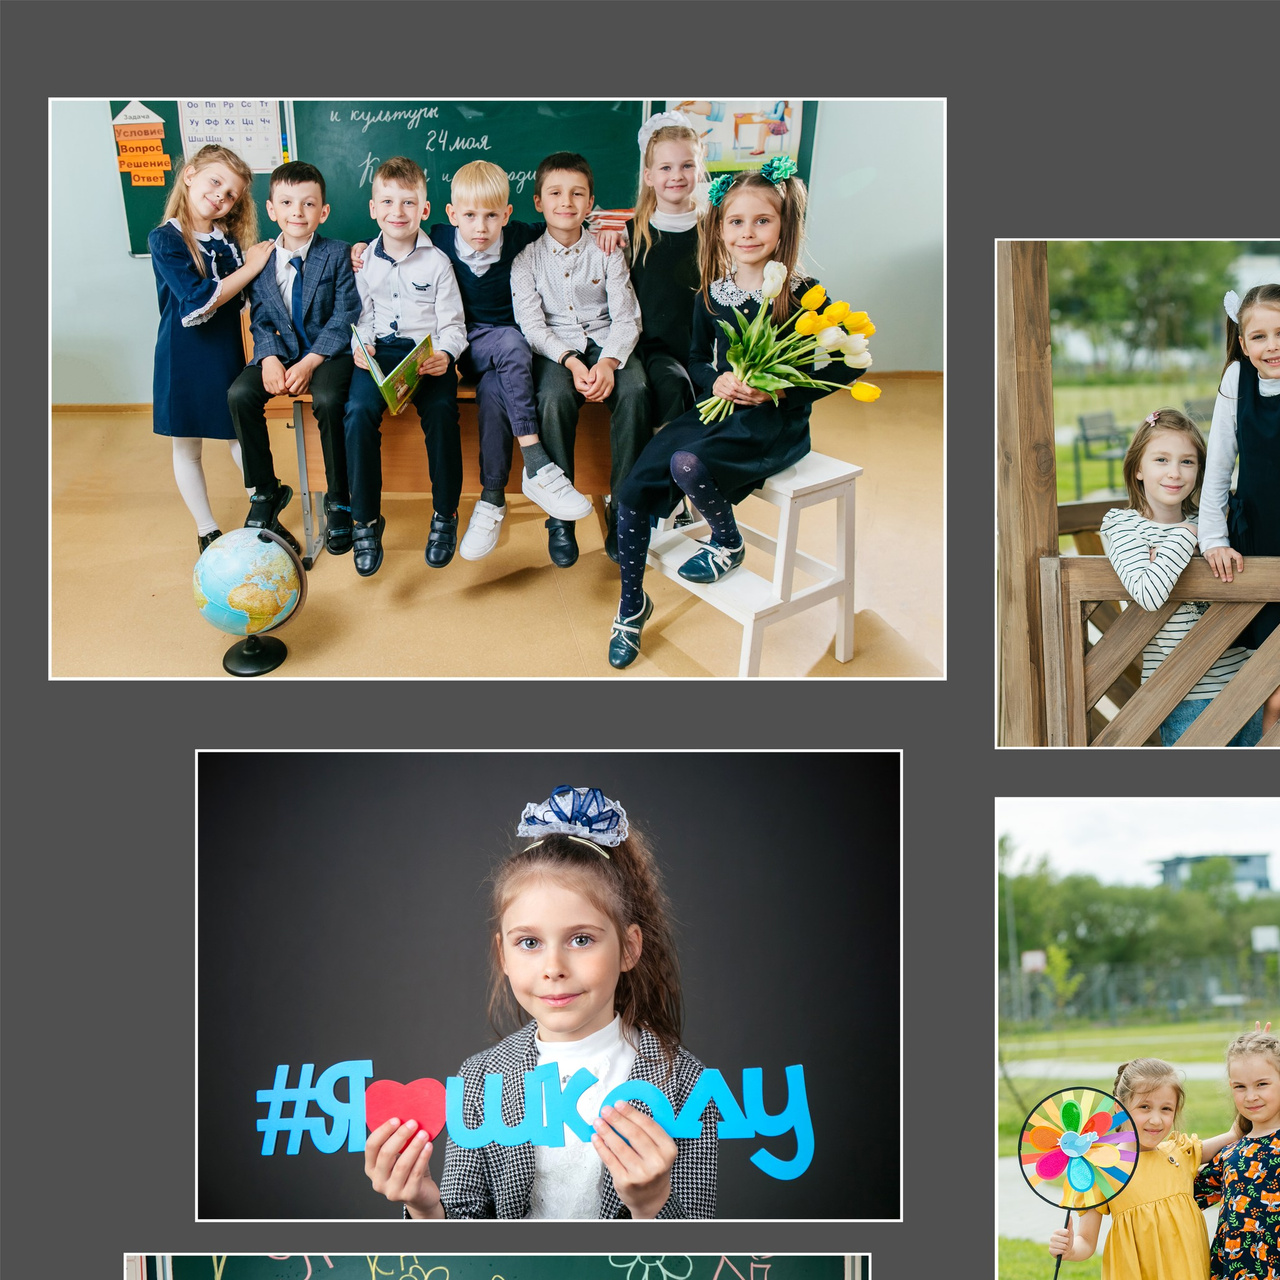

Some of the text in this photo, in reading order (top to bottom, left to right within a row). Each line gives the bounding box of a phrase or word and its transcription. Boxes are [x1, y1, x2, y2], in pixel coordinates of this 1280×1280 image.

[330, 106, 439, 133] и культуры
[115, 128, 163, 137] Условие
[426, 129, 492, 151] 24 мая
[120, 145, 162, 154] Вопрос
[119, 160, 171, 169] Решение
[133, 174, 164, 182] Ответ
